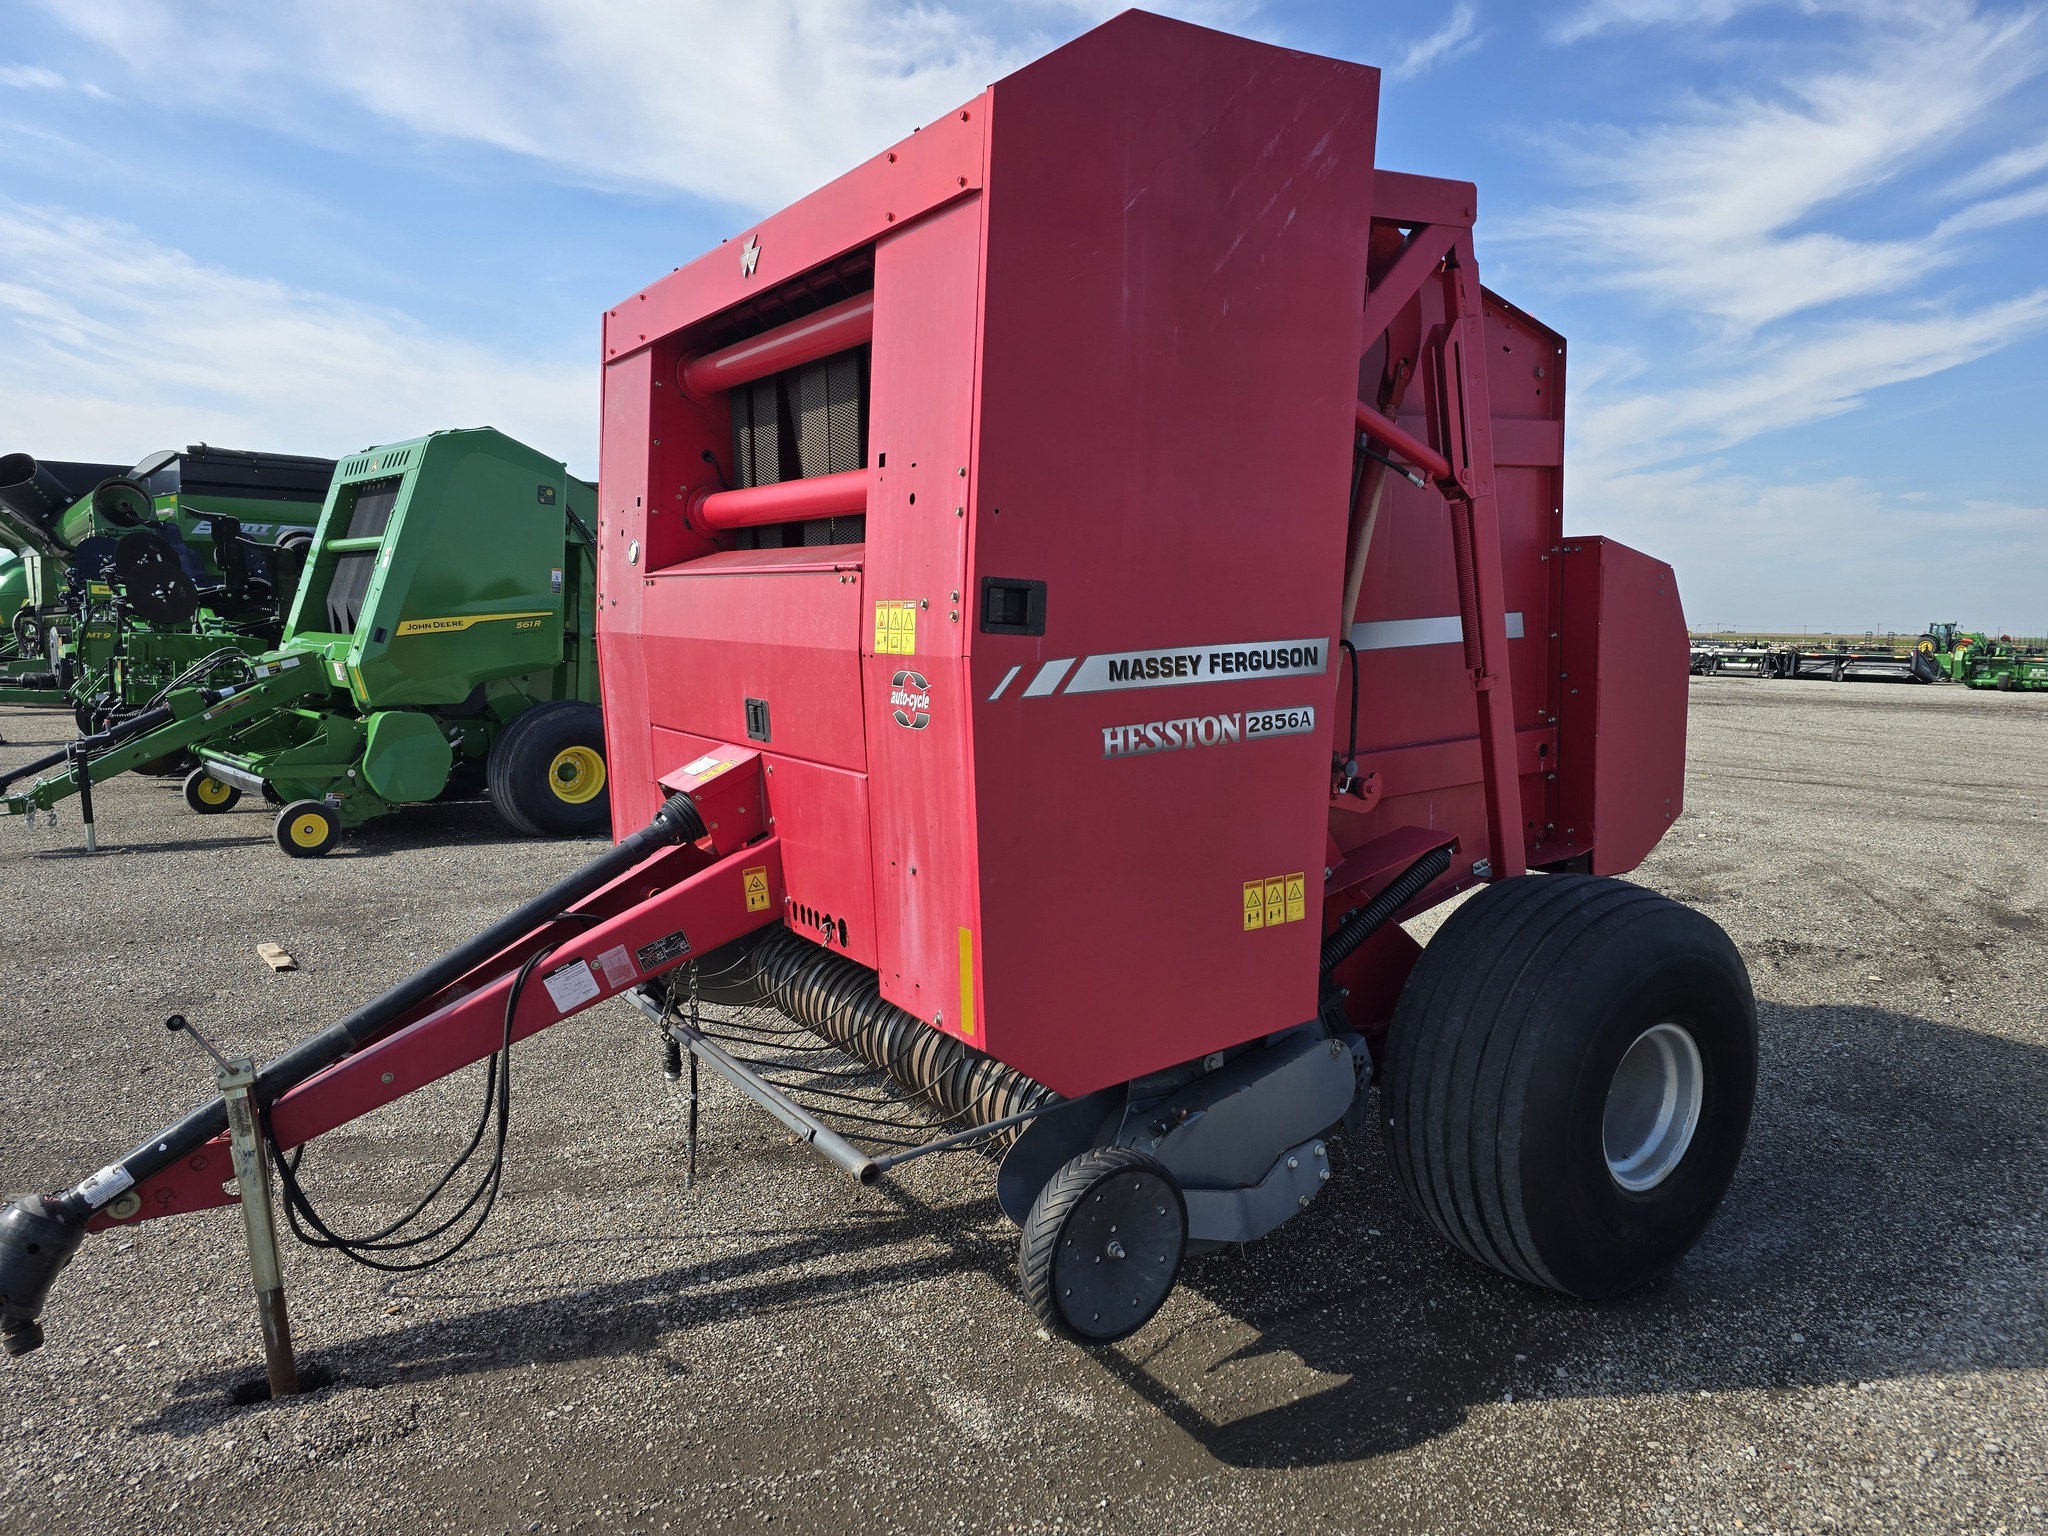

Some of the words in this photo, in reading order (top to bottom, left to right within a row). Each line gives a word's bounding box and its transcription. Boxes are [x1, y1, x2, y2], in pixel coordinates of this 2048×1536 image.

[191, 521, 274, 535] BNT
[406, 623, 431, 631] JOHN
[433, 621, 464, 629] DEERE
[1108, 653, 1202, 682] MASSEY
[1210, 646, 1318, 674] FERGUSON
[890, 688, 930, 711] auto-cycle
[1102, 713, 1241, 759] HESSTON
[1248, 710, 1312, 734] 2856A
